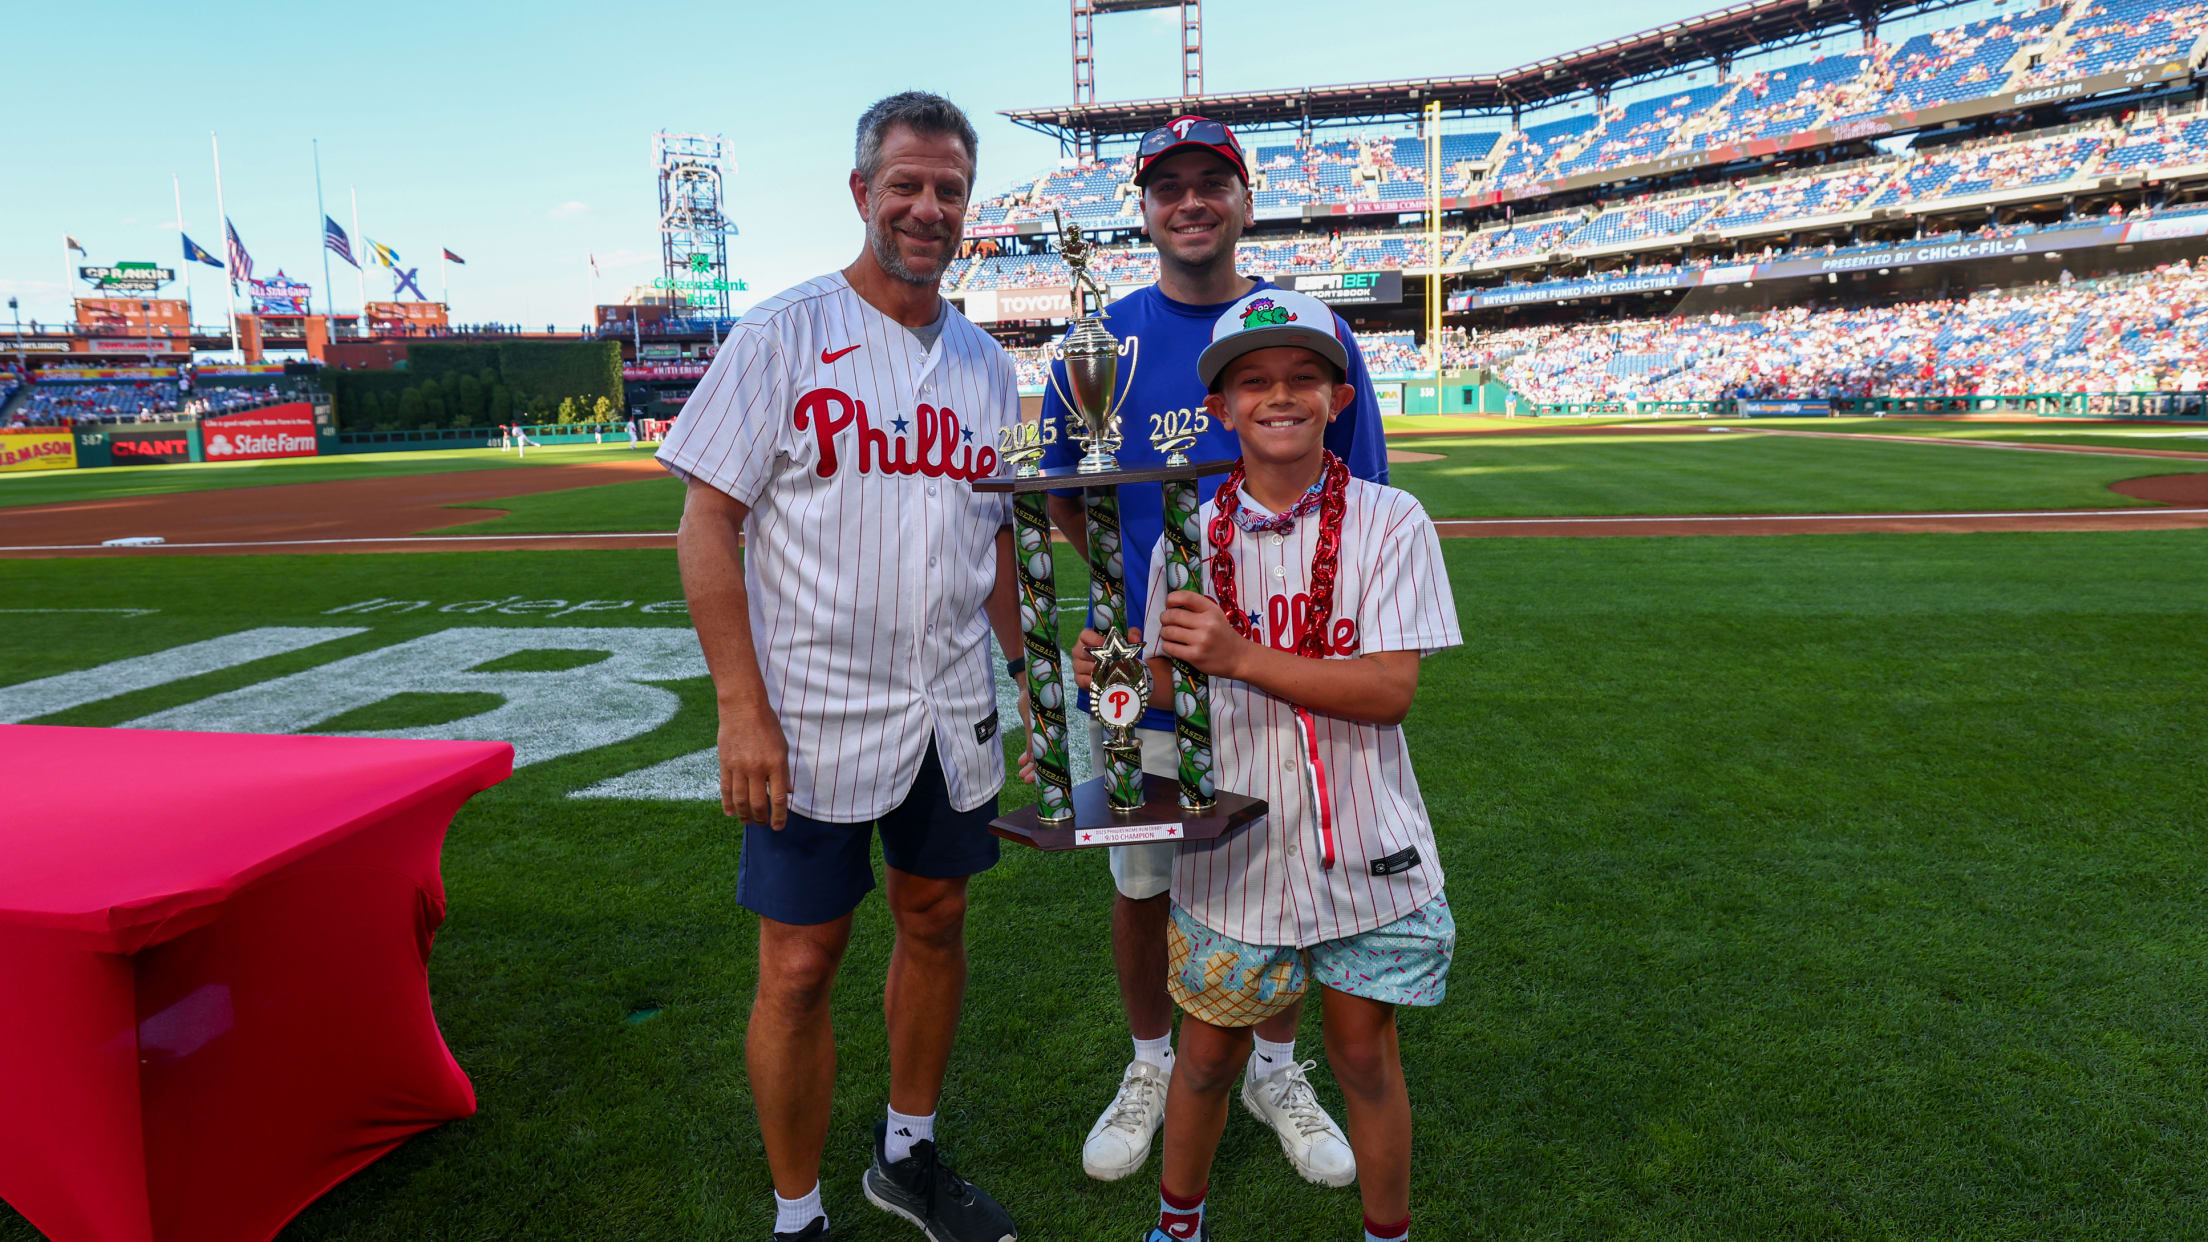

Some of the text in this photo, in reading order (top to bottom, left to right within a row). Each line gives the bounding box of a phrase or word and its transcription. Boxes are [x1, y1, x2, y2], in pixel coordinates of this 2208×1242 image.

[2061, 82, 2083, 95] PM
[1101, 218, 1136, 228] BAKERY
[1822, 238, 2027, 269] PRESENTED BY CHICK-FIL-A
[110, 267, 169, 280] RANKIN
[1343, 273, 1381, 288] BET
[102, 282, 156, 290] ROOFTOP
[654, 276, 747, 291] Citizens Bank
[1483, 276, 1679, 305] BRYCE HARPER FUNKO POP! COLLECTIBLE
[266, 286, 287, 297] STAR
[287, 286, 311, 297] GAME
[687, 293, 717, 305] Park
[1304, 288, 1371, 298] SPORTSBOOK
[1000, 294, 1072, 313] TOYOTA
[1149, 406, 1210, 440] 2025
[793, 387, 1000, 483] Phillie
[998, 417, 1058, 452] 2025
[112, 439, 188, 456] GIANT
[1108, 690, 1130, 719] P
[1120, 832, 1155, 841] CHAMPION
